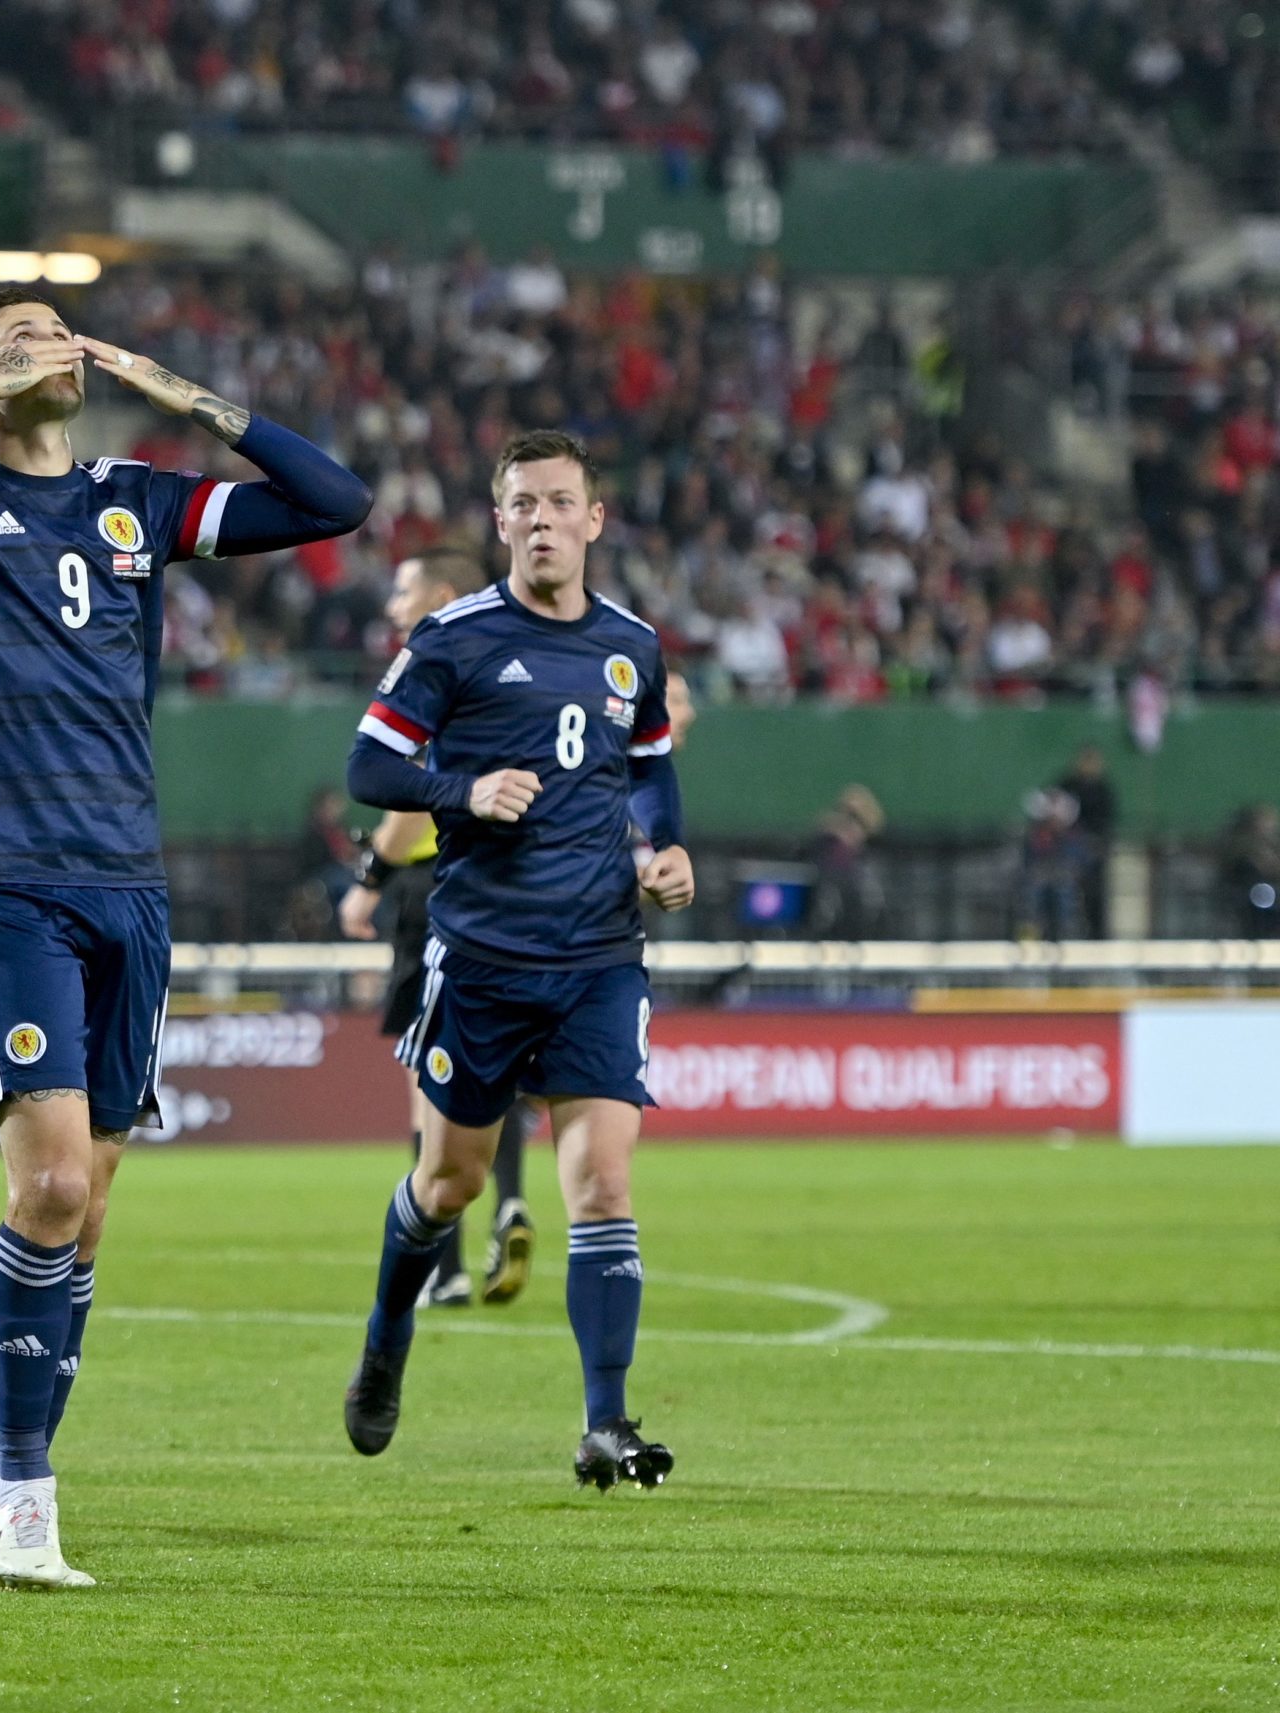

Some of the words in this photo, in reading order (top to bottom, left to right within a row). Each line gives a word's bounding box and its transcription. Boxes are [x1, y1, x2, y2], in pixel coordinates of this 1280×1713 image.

[58, 552, 91, 629] 9
[556, 703, 587, 770] 8
[648, 1043, 836, 1110] ROPEAN
[840, 1043, 1110, 1110] QUALIFIERS
